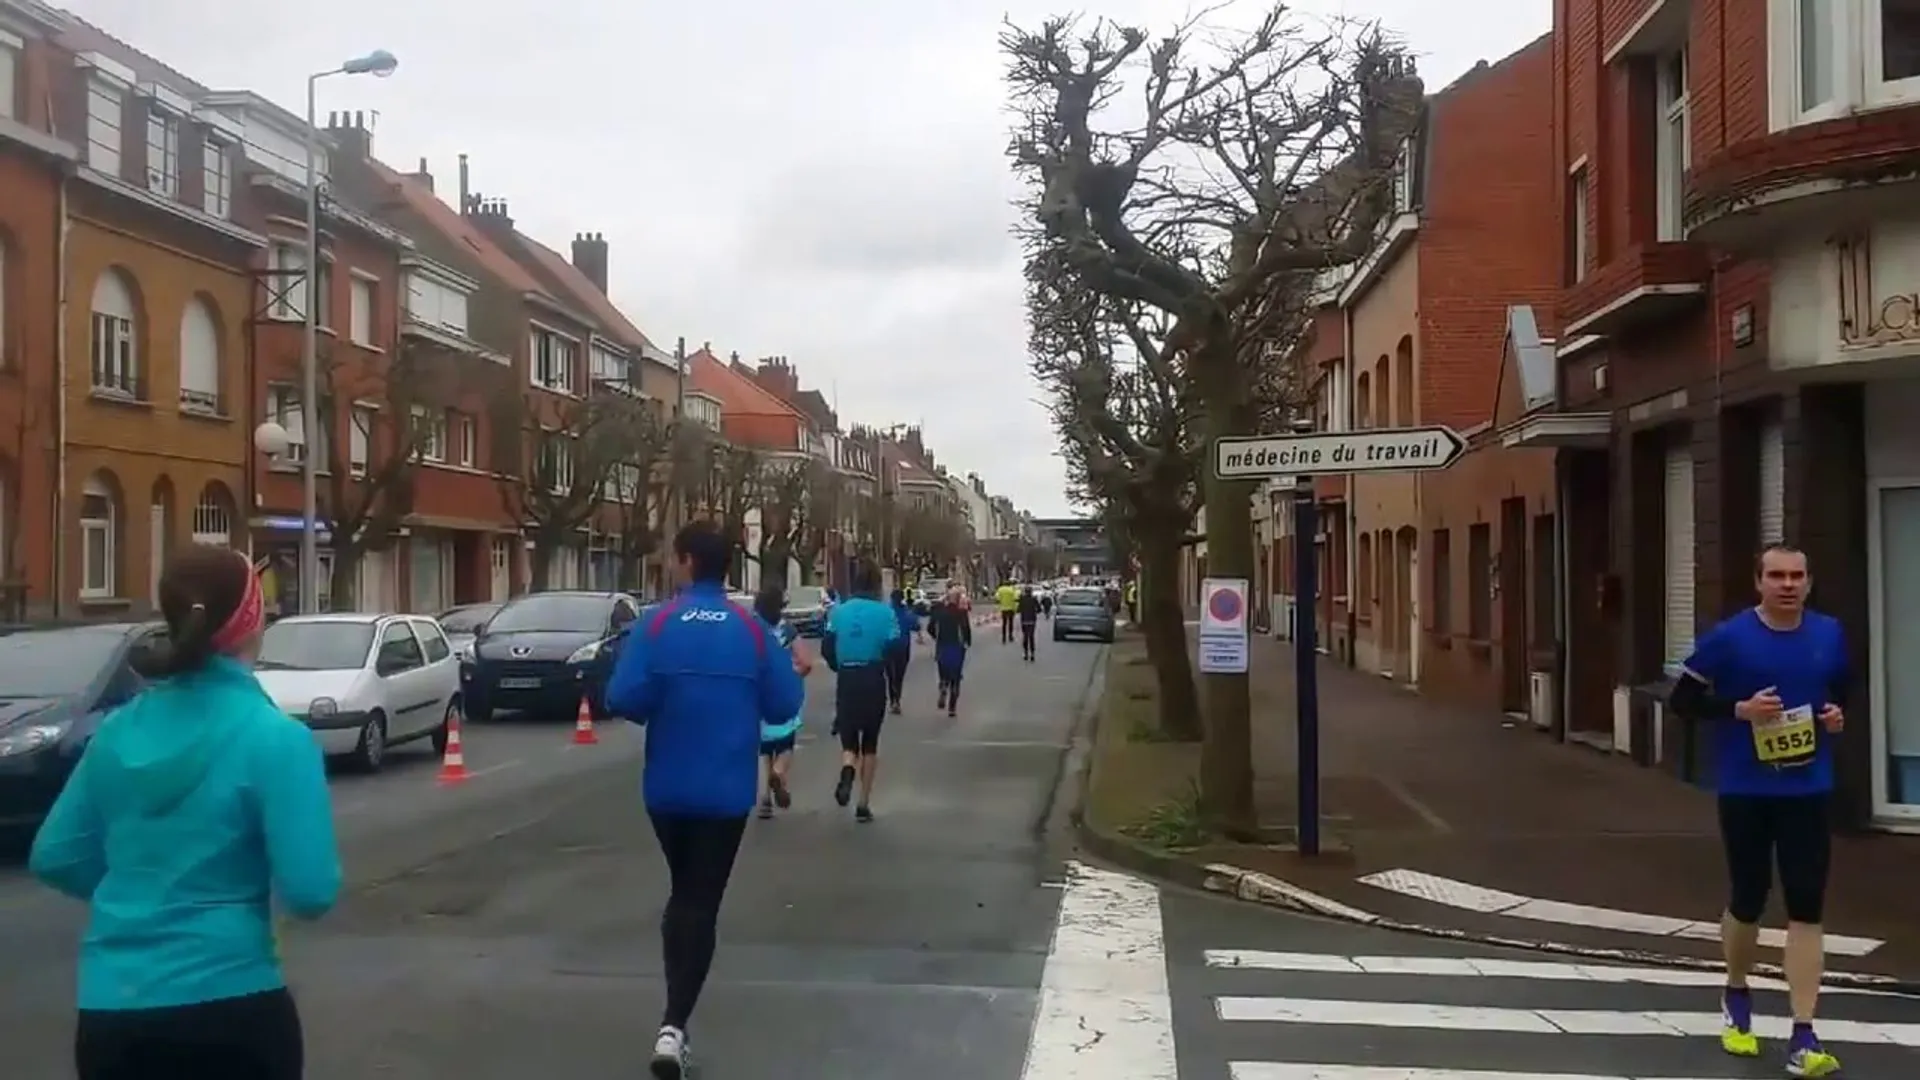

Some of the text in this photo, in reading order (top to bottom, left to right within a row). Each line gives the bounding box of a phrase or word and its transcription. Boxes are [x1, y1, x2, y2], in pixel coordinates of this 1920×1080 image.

[1226, 438, 1438, 468] médecine du travail
[1763, 729, 1814, 753] 1552
